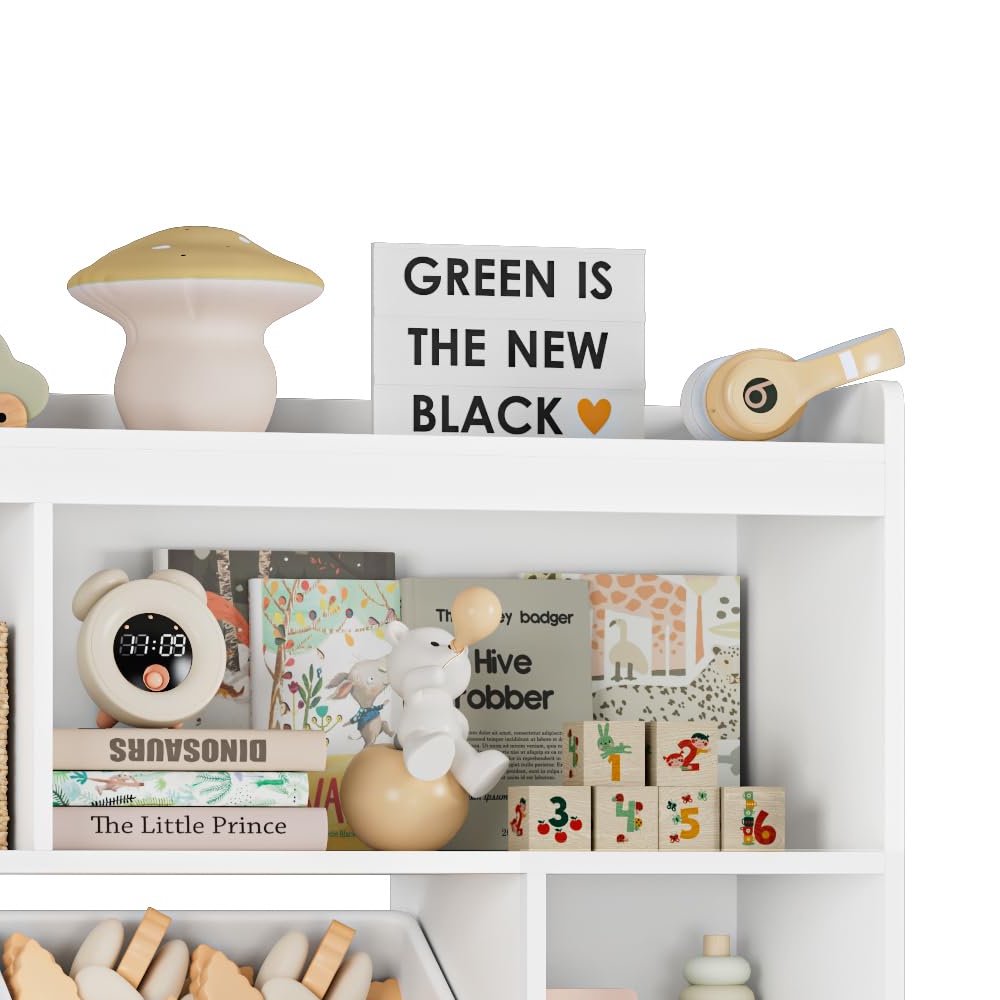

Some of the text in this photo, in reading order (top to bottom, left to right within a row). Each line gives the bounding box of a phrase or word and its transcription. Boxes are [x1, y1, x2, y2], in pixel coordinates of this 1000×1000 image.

[404, 256, 613, 300] GREEN IS
[407, 327, 609, 369] THE NEW
[413, 394, 563, 435] BLACK
[435, 608, 453, 623] Th
[519, 610, 574, 627] badger
[474, 649, 532, 674] Hive
[109, 737, 267, 762] DINOSAURS
[676, 739, 701, 772] 2
[607, 754, 620, 782] 1
[90, 815, 287, 835] The Little Prince
[548, 796, 568, 827] 3
[616, 800, 635, 833] 4
[680, 807, 700, 840] 5
[754, 810, 777, 845] 6
